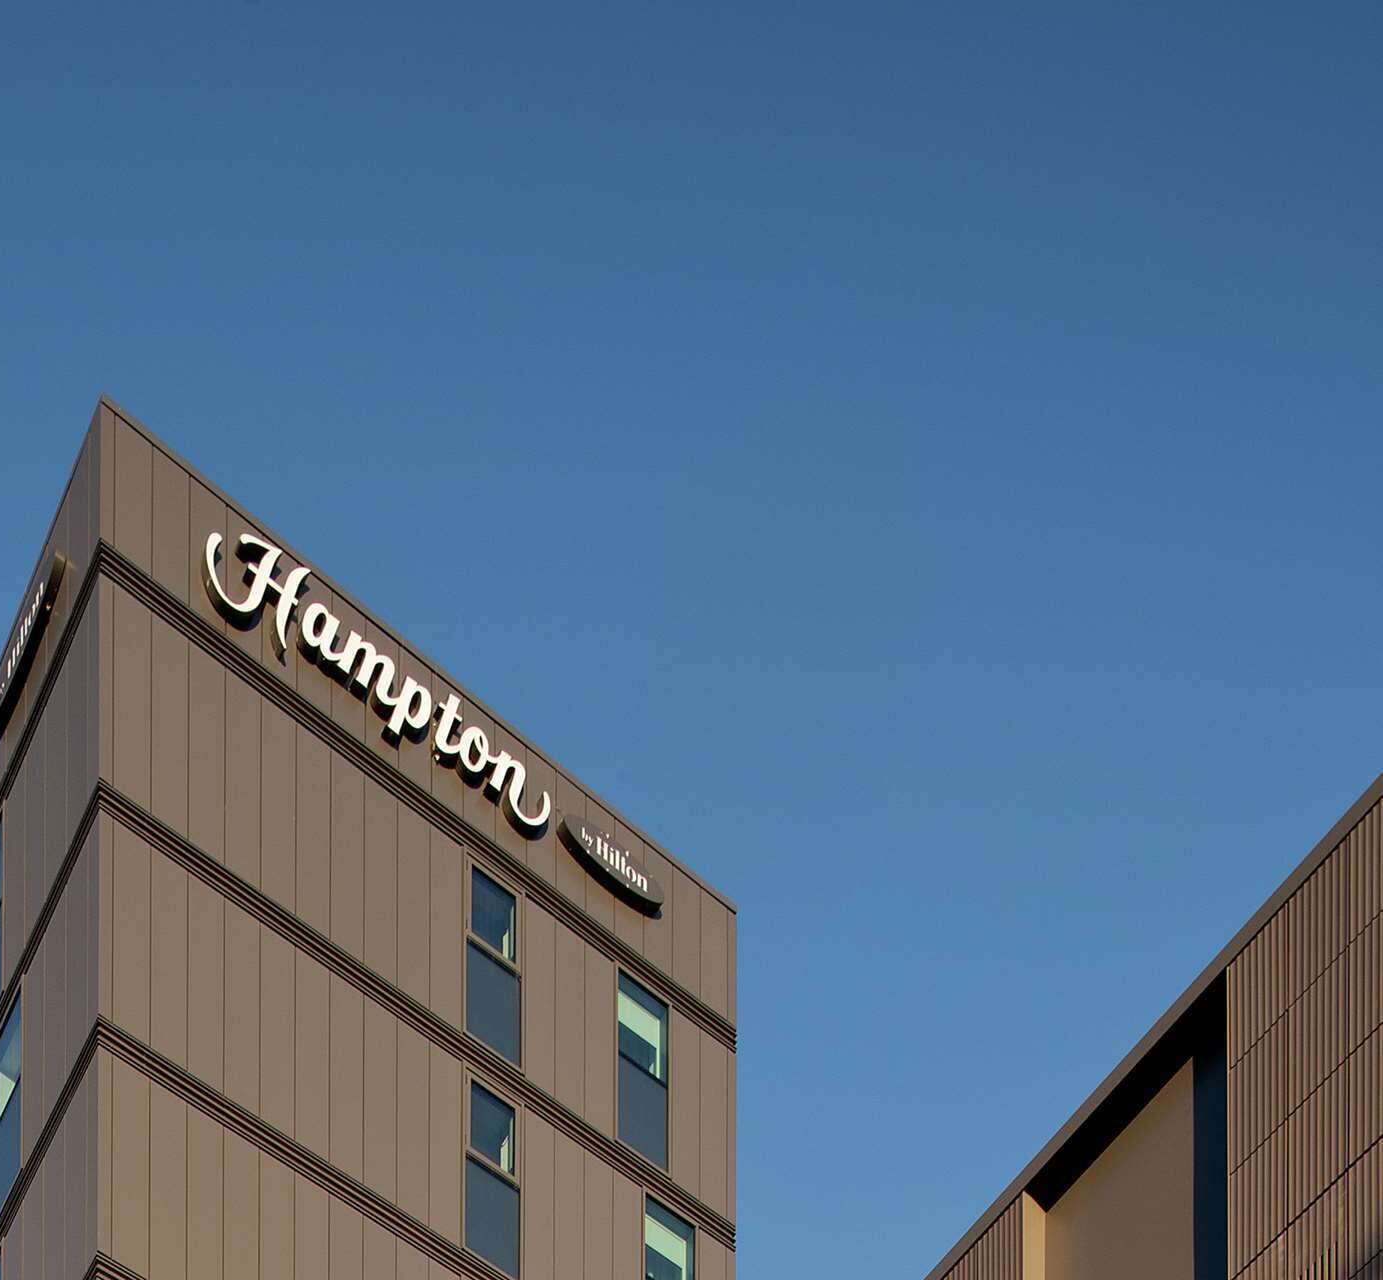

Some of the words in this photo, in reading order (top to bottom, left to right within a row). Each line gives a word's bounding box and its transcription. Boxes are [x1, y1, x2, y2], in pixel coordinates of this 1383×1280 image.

[205, 531, 551, 827] Hampton
[581, 826, 594, 847] by
[596, 835, 649, 893] Hilton
